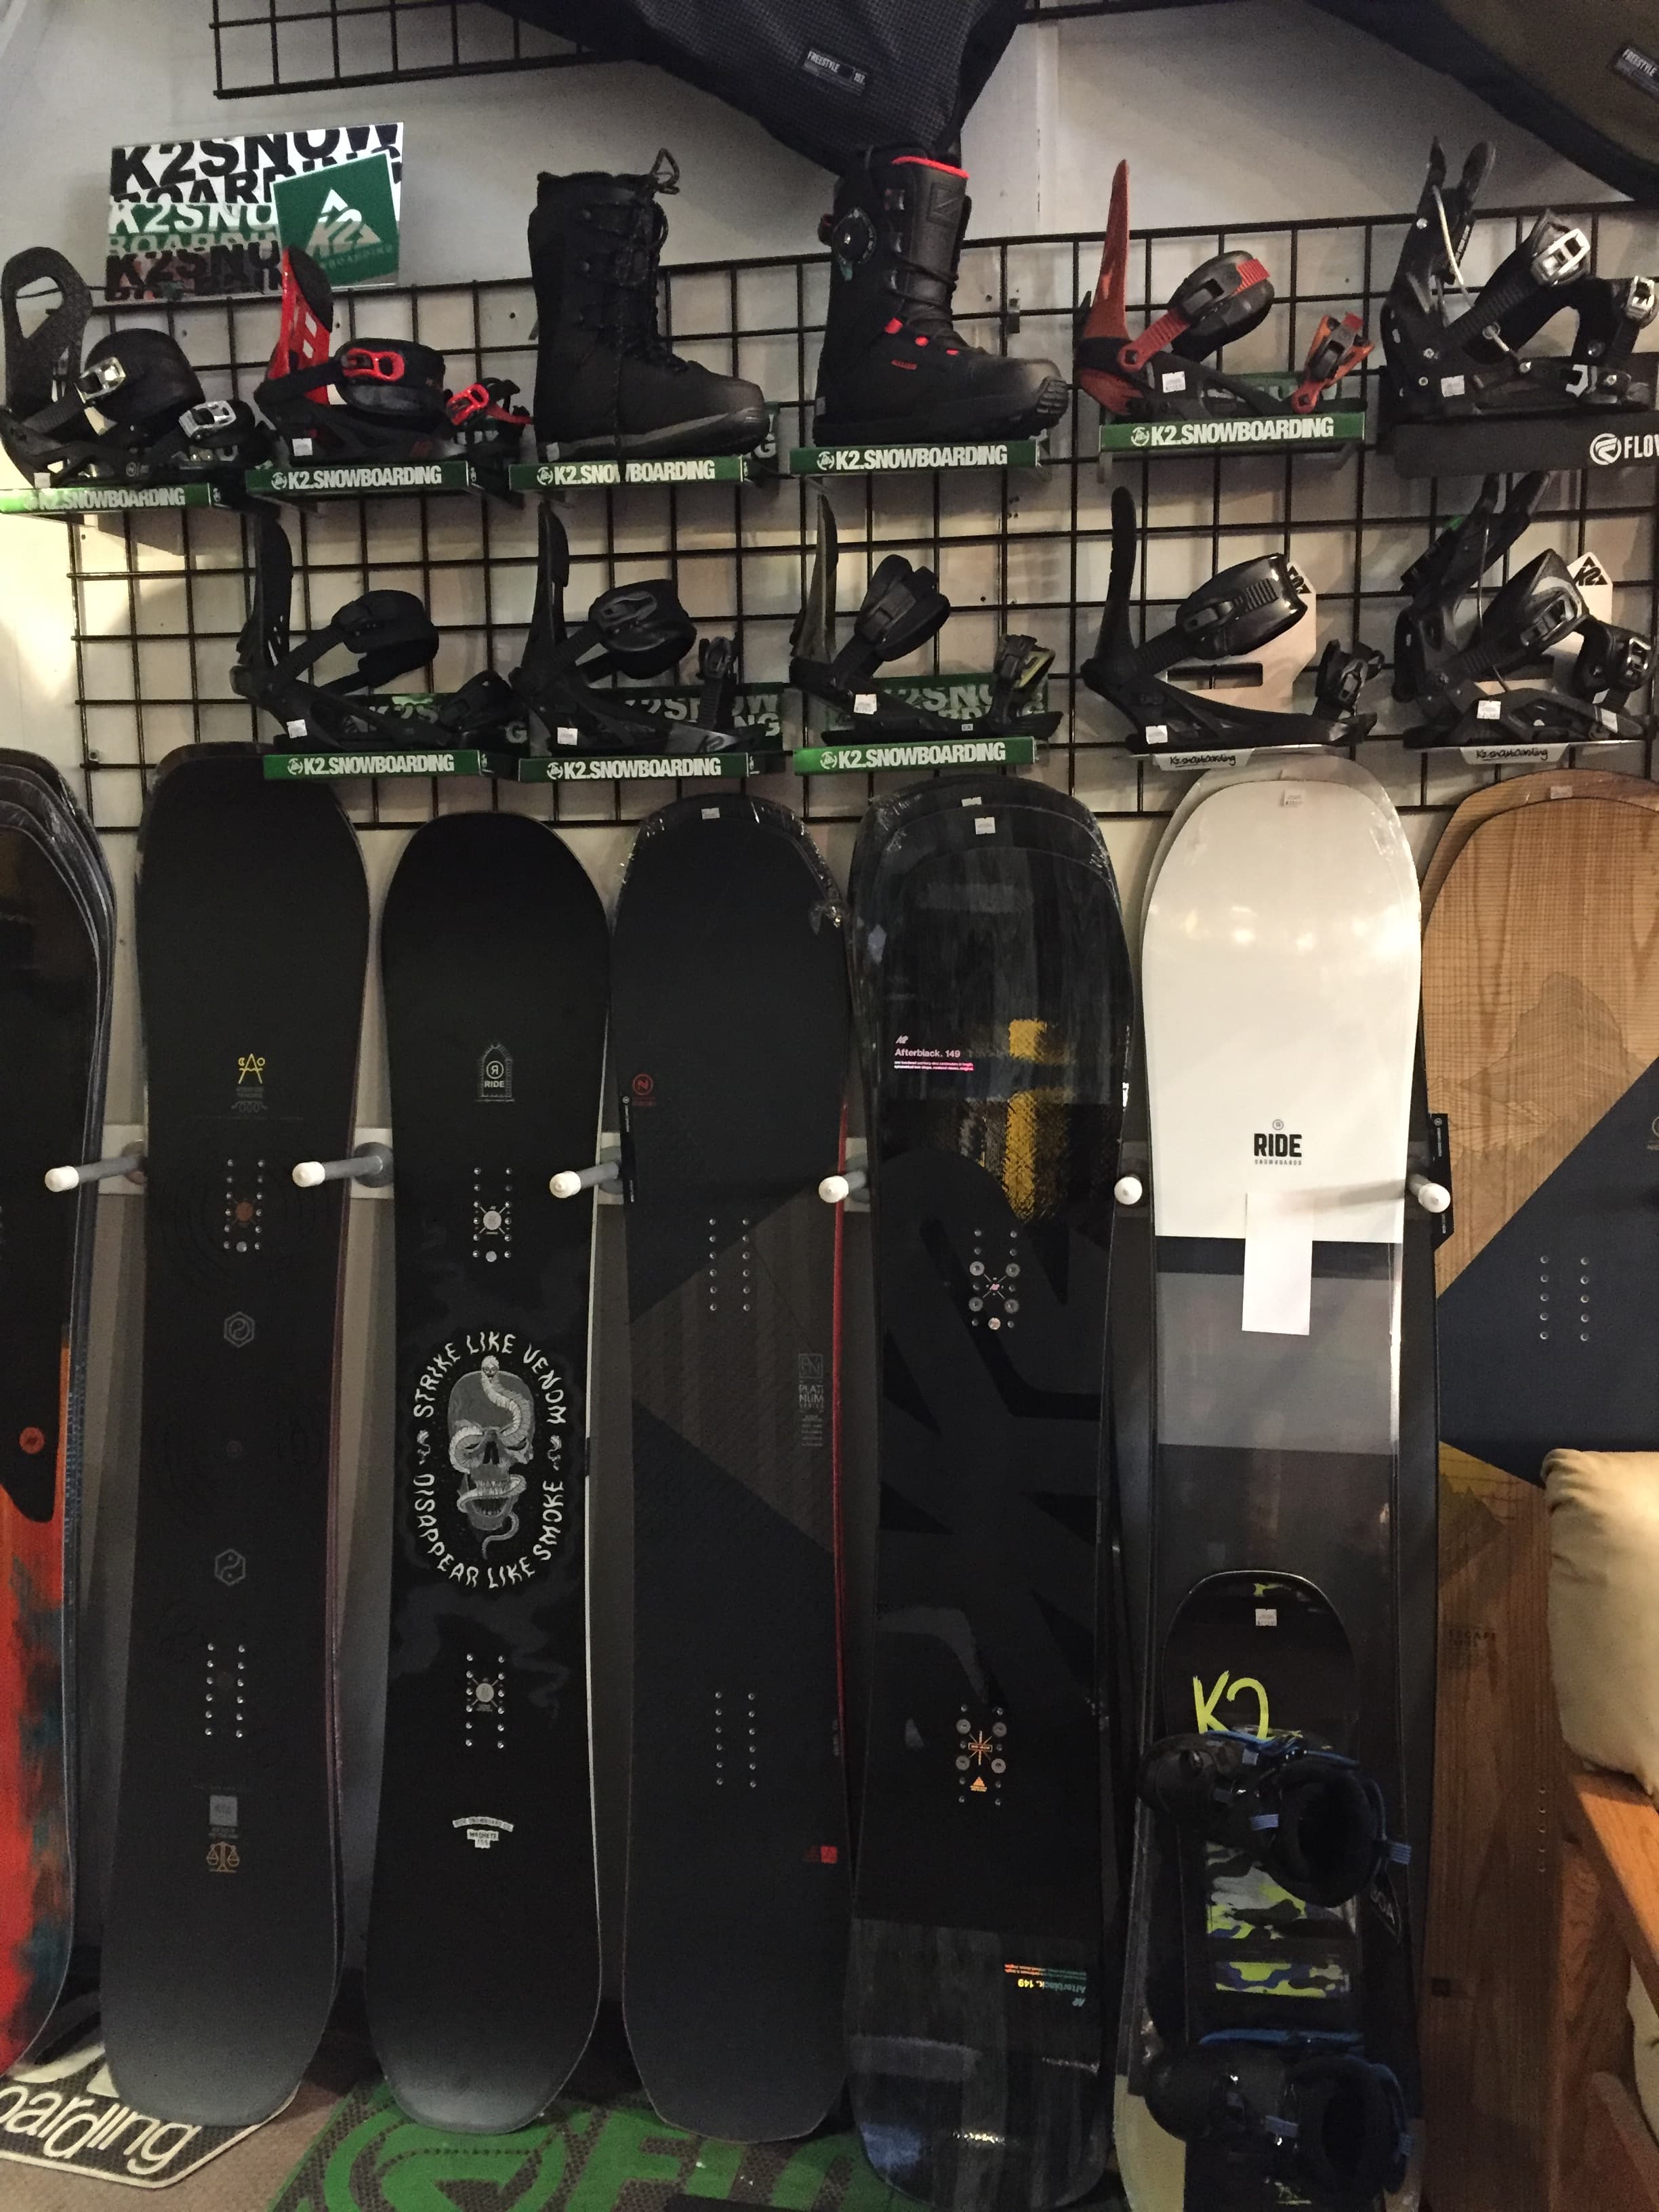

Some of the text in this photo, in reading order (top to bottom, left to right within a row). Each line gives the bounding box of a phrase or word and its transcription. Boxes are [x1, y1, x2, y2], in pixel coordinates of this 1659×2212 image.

[807, 51, 840, 73] FREESTYLE
[1151, 417, 1334, 445] K2.SNOWBOARDING
[836, 445, 1008, 470] K2.SNOWBOARDING
[288, 465, 442, 490] K2.SNOWBOARDING
[304, 754, 454, 775] K2.SNOWBOARDING
[838, 741, 1006, 770] K2.SNOWBOARDING
[564, 758, 721, 779] K2.SNOWBOARDING
[945, 1049, 961, 1058] 149
[1254, 1133, 1302, 1158] RIDE
[413, 1331, 566, 1425] STRIKE LIKE VENOM
[413, 1473, 564, 1589] DISAPPEAR LIKE SMOKE
[1193, 1670, 1276, 1741] K2
